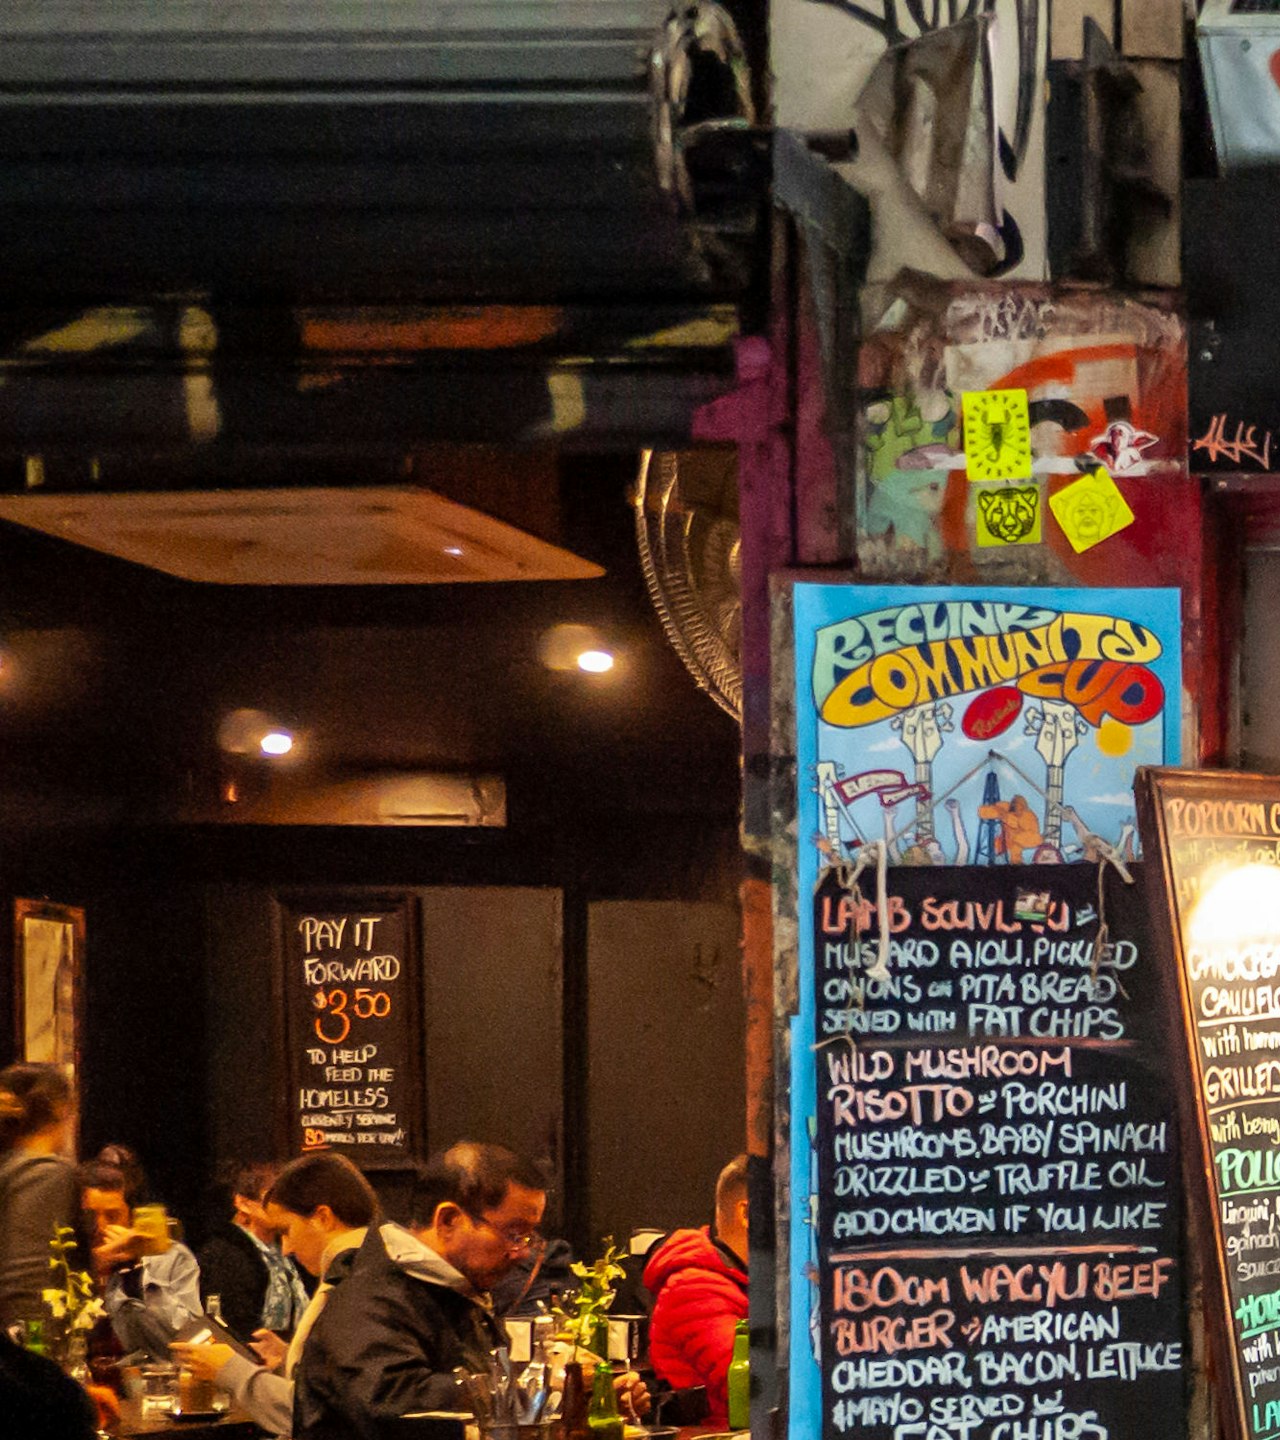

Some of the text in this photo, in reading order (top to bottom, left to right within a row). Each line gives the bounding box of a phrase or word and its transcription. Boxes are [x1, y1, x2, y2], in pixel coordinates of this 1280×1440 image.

[812, 601, 1057, 714] RECLINK
[820, 613, 1163, 727] COMMUNITY
[1017, 661, 1165, 728] CUP
[1168, 799, 1267, 836] POPCORN
[821, 896, 911, 934] LAMB
[300, 918, 381, 953] PAY IT
[304, 955, 399, 984] FORWARD
[1034, 938, 1138, 970] PICKLED
[824, 974, 1116, 1003] ONIONS PITA BREAD
[822, 1004, 1124, 1040] SERVED WITH FAT CHIPS
[307, 1045, 376, 1064] TO HELP
[827, 1047, 1072, 1085] WILD MUSHROOM
[326, 1067, 394, 1081] FEED THE
[300, 1088, 388, 1109] HOMELESS
[828, 1082, 1125, 1125] RISOTTO PORCHINI
[980, 1123, 1051, 1157] BABY
[1058, 1123, 1167, 1155] SPINACH
[833, 1159, 1164, 1196] DRIZZLED TRUFFLE OIL
[833, 1203, 1167, 1238] ADD CHICKEN IF YOU LIKE
[961, 1263, 1088, 1307] WAGYU
[1095, 1258, 1174, 1300] BEEF
[832, 1306, 1120, 1356] BURGER AMERICAN
[1087, 1342, 1182, 1380] LETTUCE
[931, 1396, 1025, 1423] SERVED
